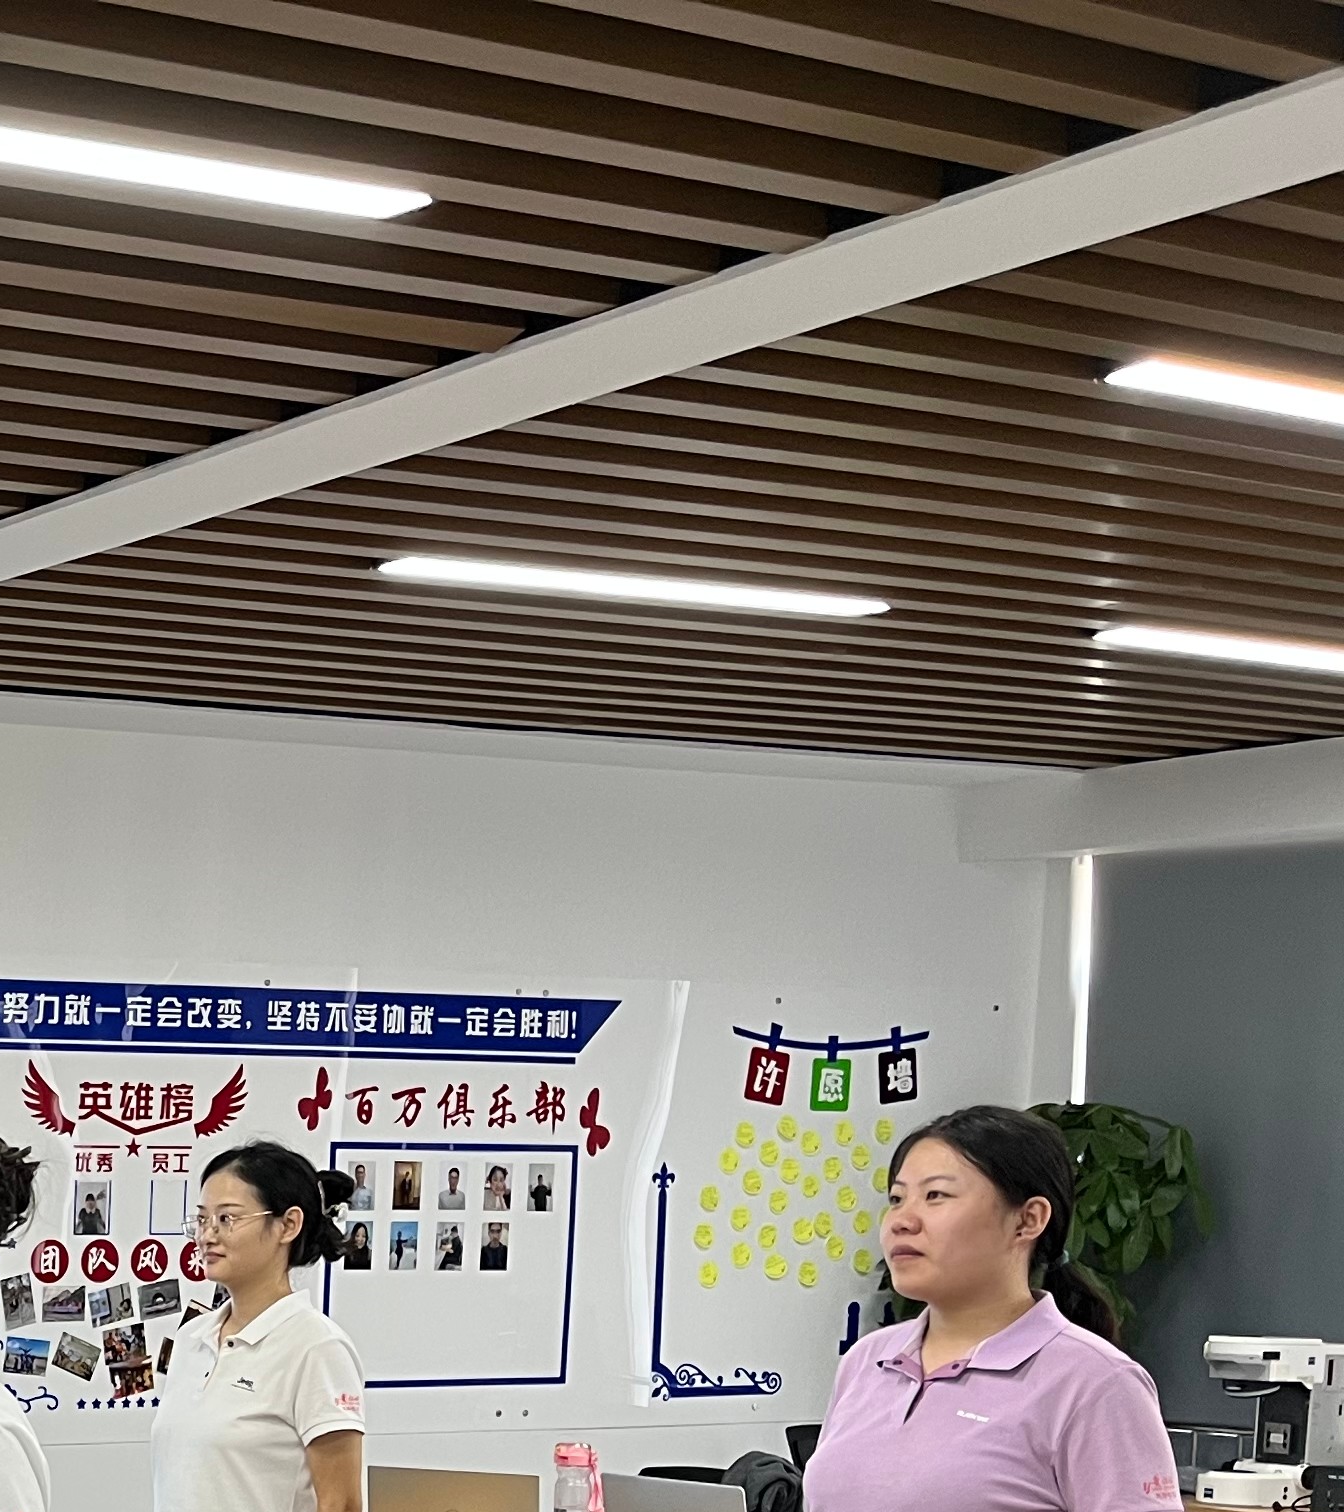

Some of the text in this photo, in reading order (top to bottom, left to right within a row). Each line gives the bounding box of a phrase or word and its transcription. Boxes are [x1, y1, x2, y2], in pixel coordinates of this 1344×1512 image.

[77, 1081, 194, 1122] 英雄榜
[345, 1080, 566, 1136] 百万俱乐部
[75, 1152, 190, 1174] 优秀 员工
